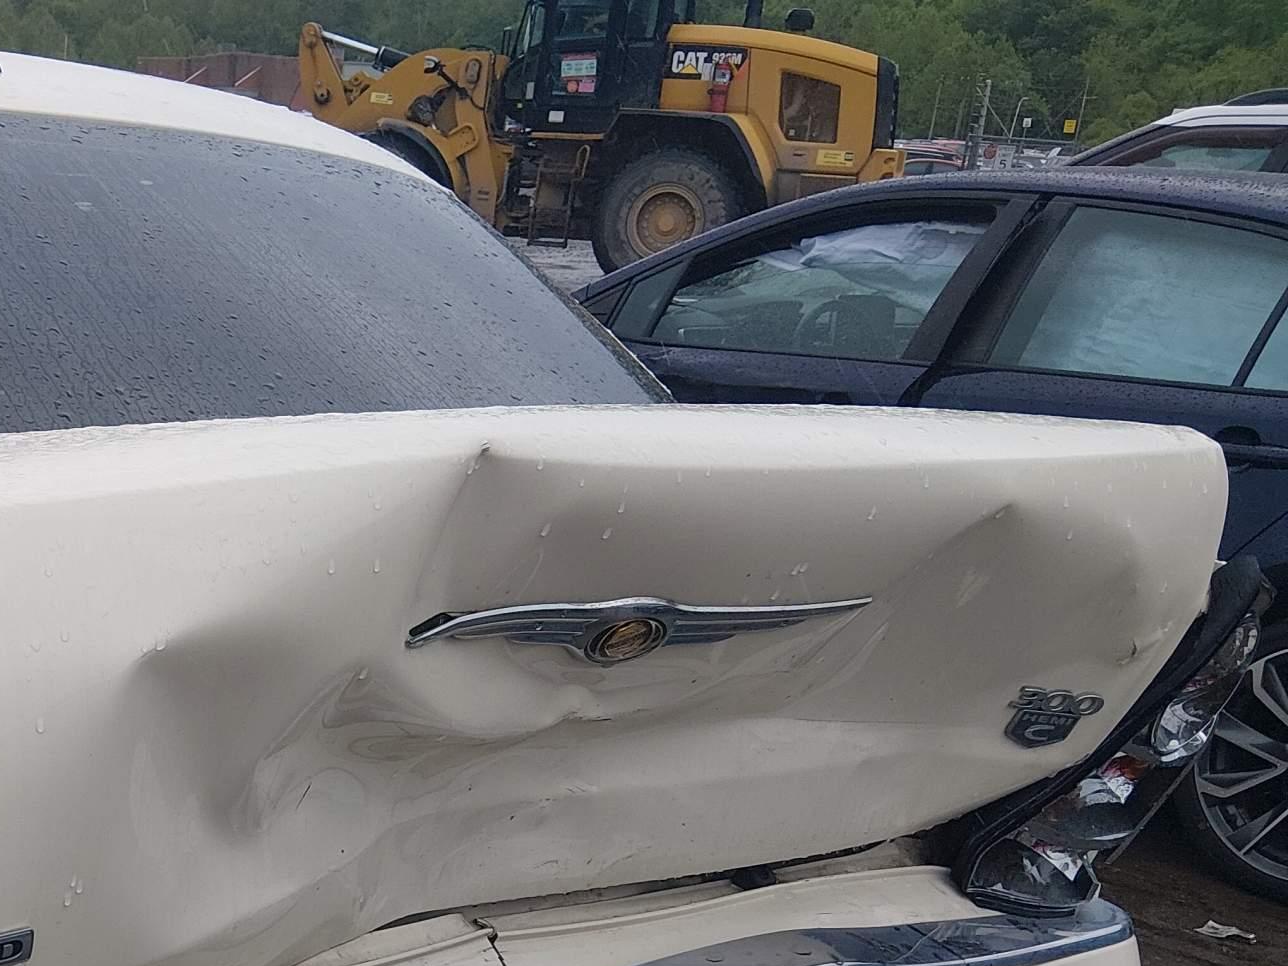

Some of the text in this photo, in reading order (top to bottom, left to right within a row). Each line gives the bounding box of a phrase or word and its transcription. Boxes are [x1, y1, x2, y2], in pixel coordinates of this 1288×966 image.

[671, 50, 709, 74] CAT
[1007, 685, 1105, 716] 300
[1022, 713, 1073, 727] HEMI
[1023, 724, 1056, 741] C
